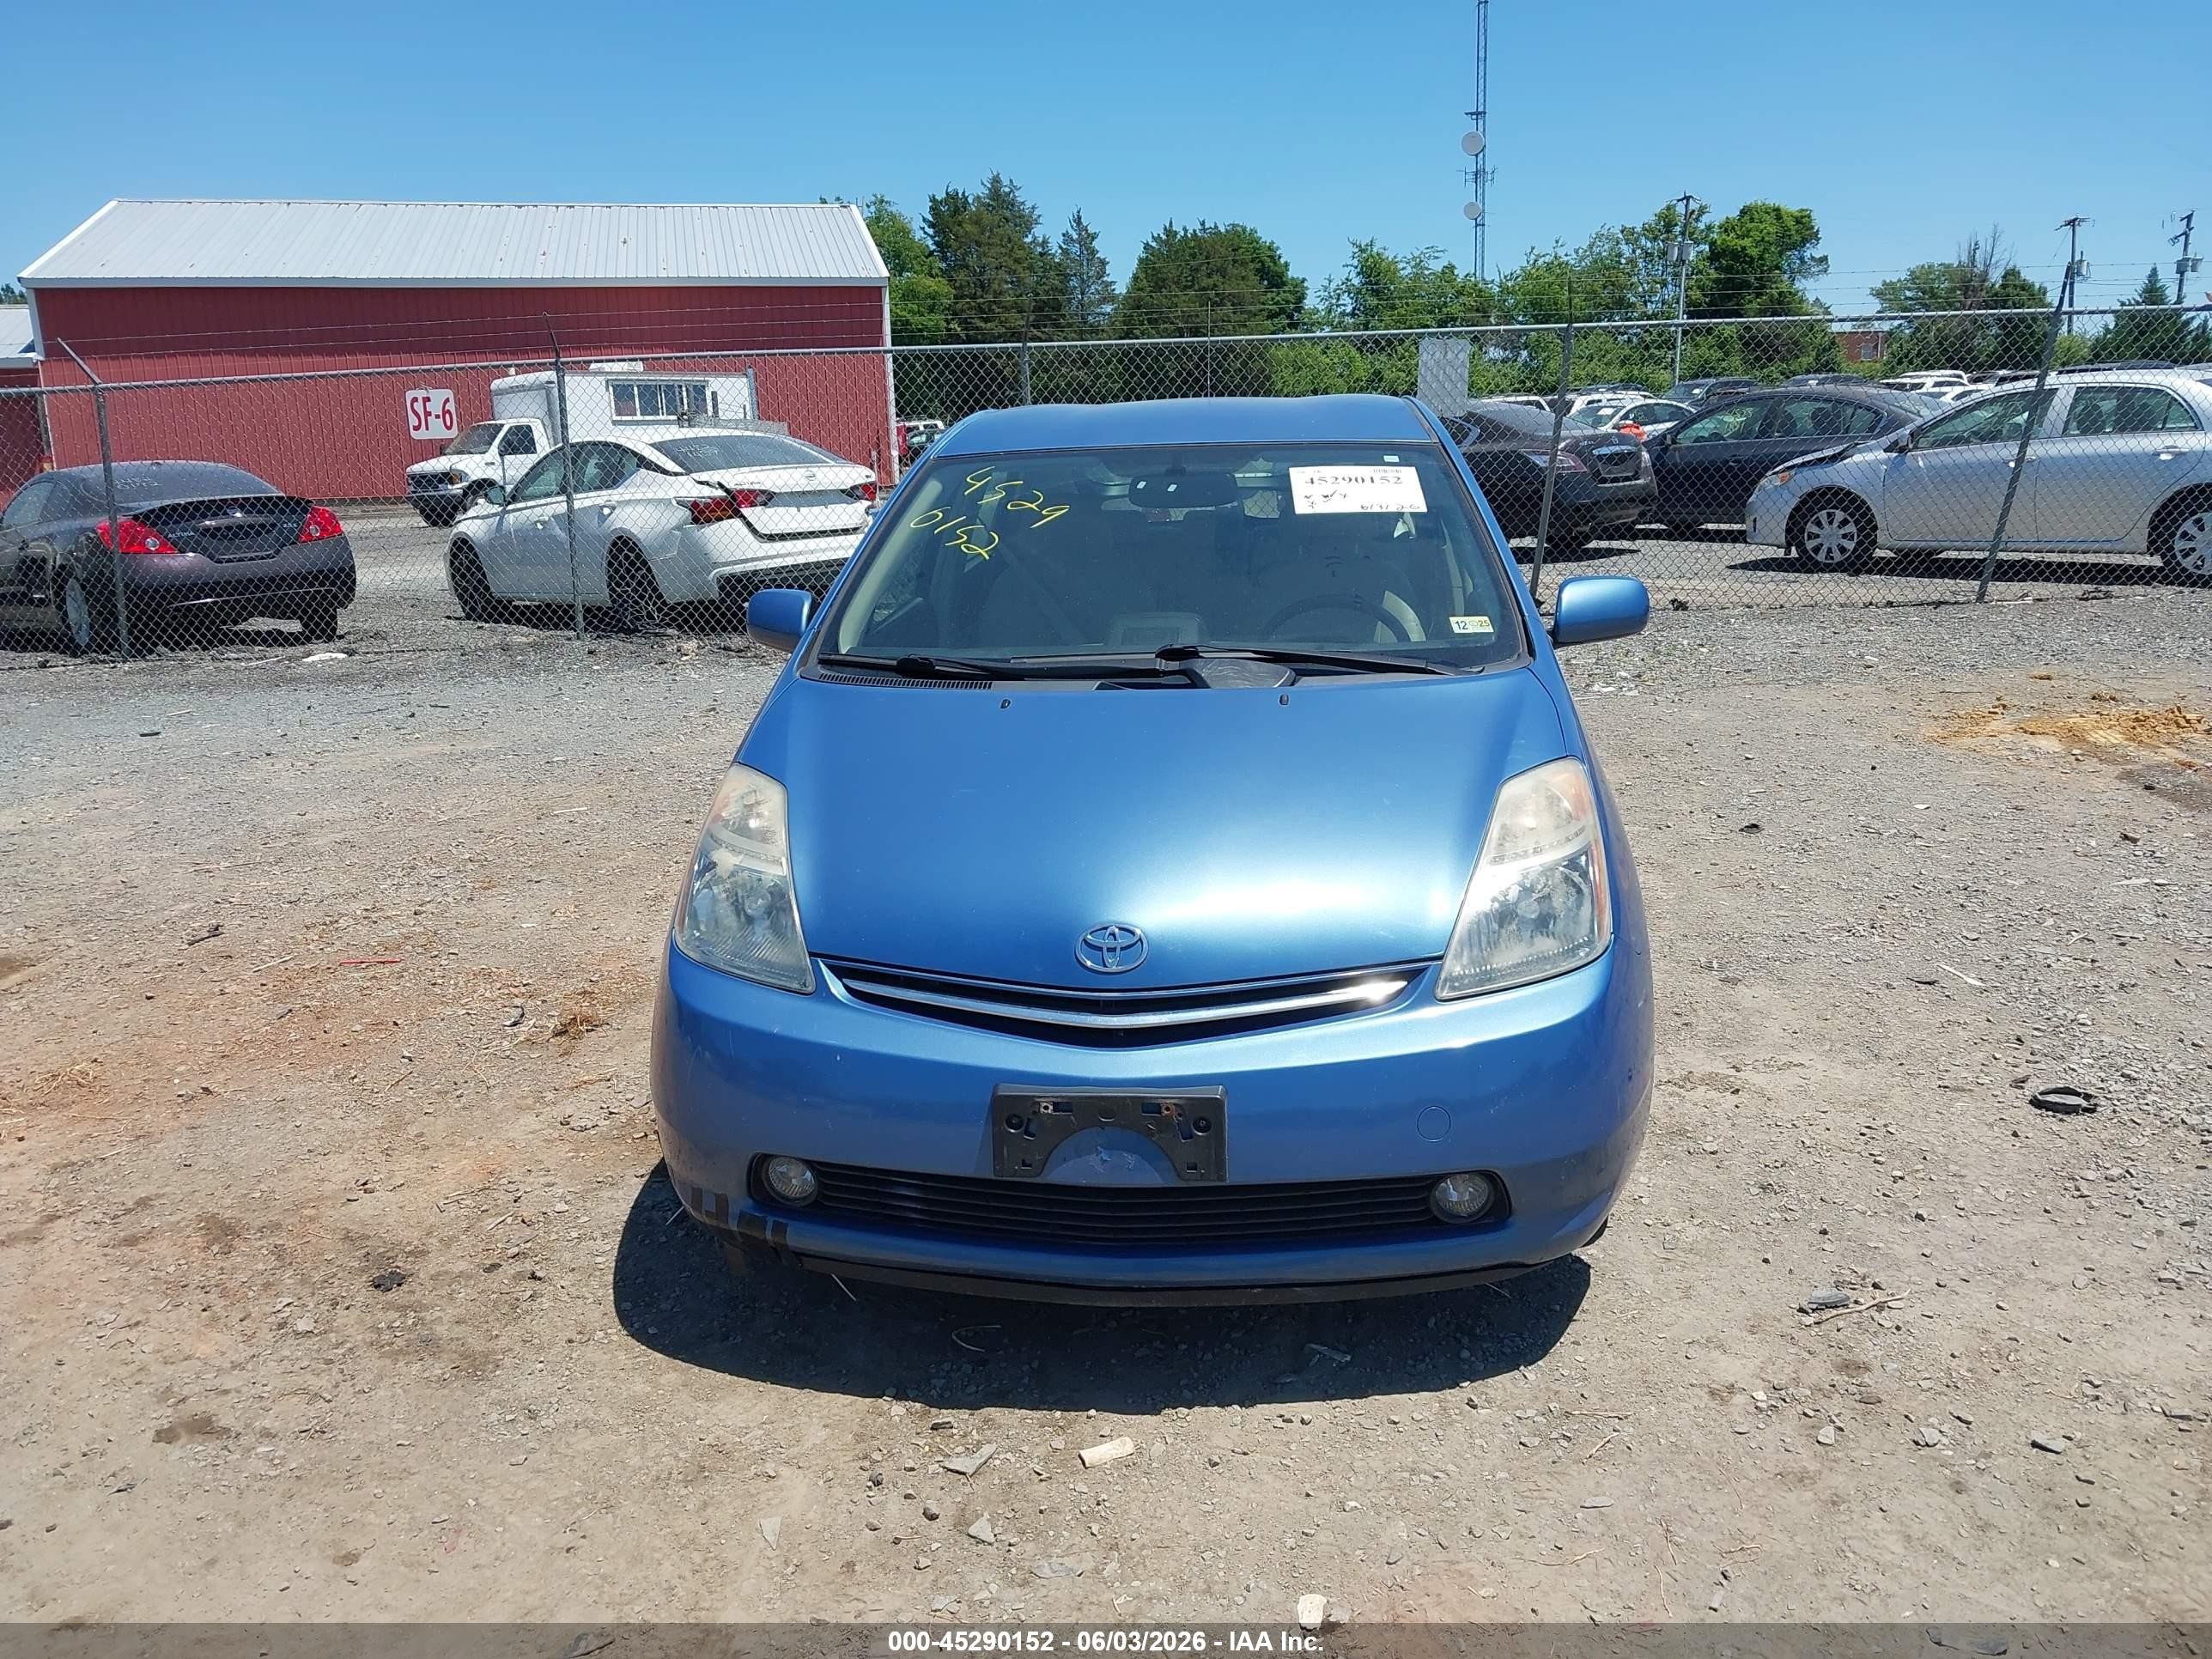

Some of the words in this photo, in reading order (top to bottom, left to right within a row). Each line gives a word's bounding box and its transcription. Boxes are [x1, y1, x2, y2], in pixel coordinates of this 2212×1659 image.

[410, 396, 454, 432] SF-6
[964, 465, 1071, 529] 4529
[1304, 476, 1403, 486] 45290152
[910, 506, 1000, 560] 0152
[1455, 620, 1468, 630] 12
